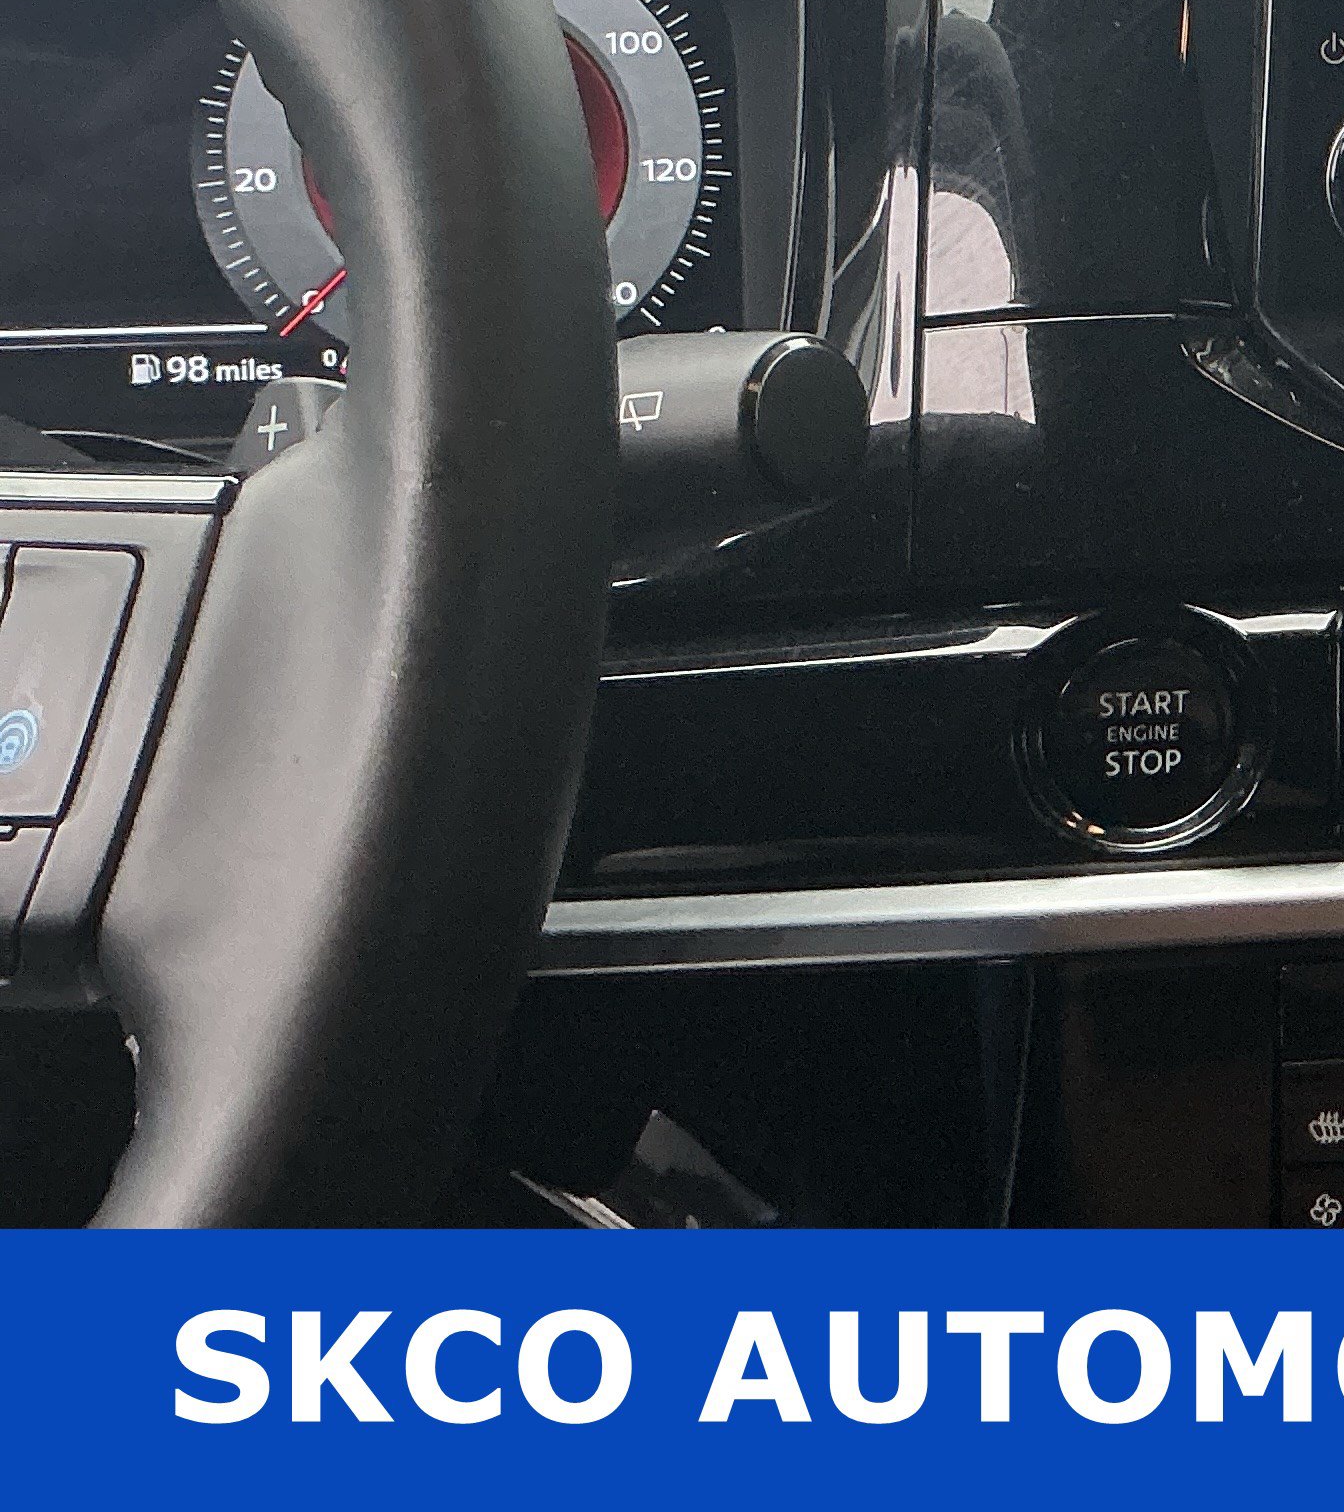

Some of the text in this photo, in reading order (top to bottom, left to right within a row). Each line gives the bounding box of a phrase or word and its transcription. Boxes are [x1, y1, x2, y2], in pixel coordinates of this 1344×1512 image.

[604, 29, 664, 56] 100
[233, 167, 277, 193] 20
[639, 157, 697, 183] 120
[165, 354, 285, 384] 98 miles
[1099, 689, 1191, 717] START
[1106, 723, 1179, 743] ENGINE
[1105, 748, 1182, 777] STOP
